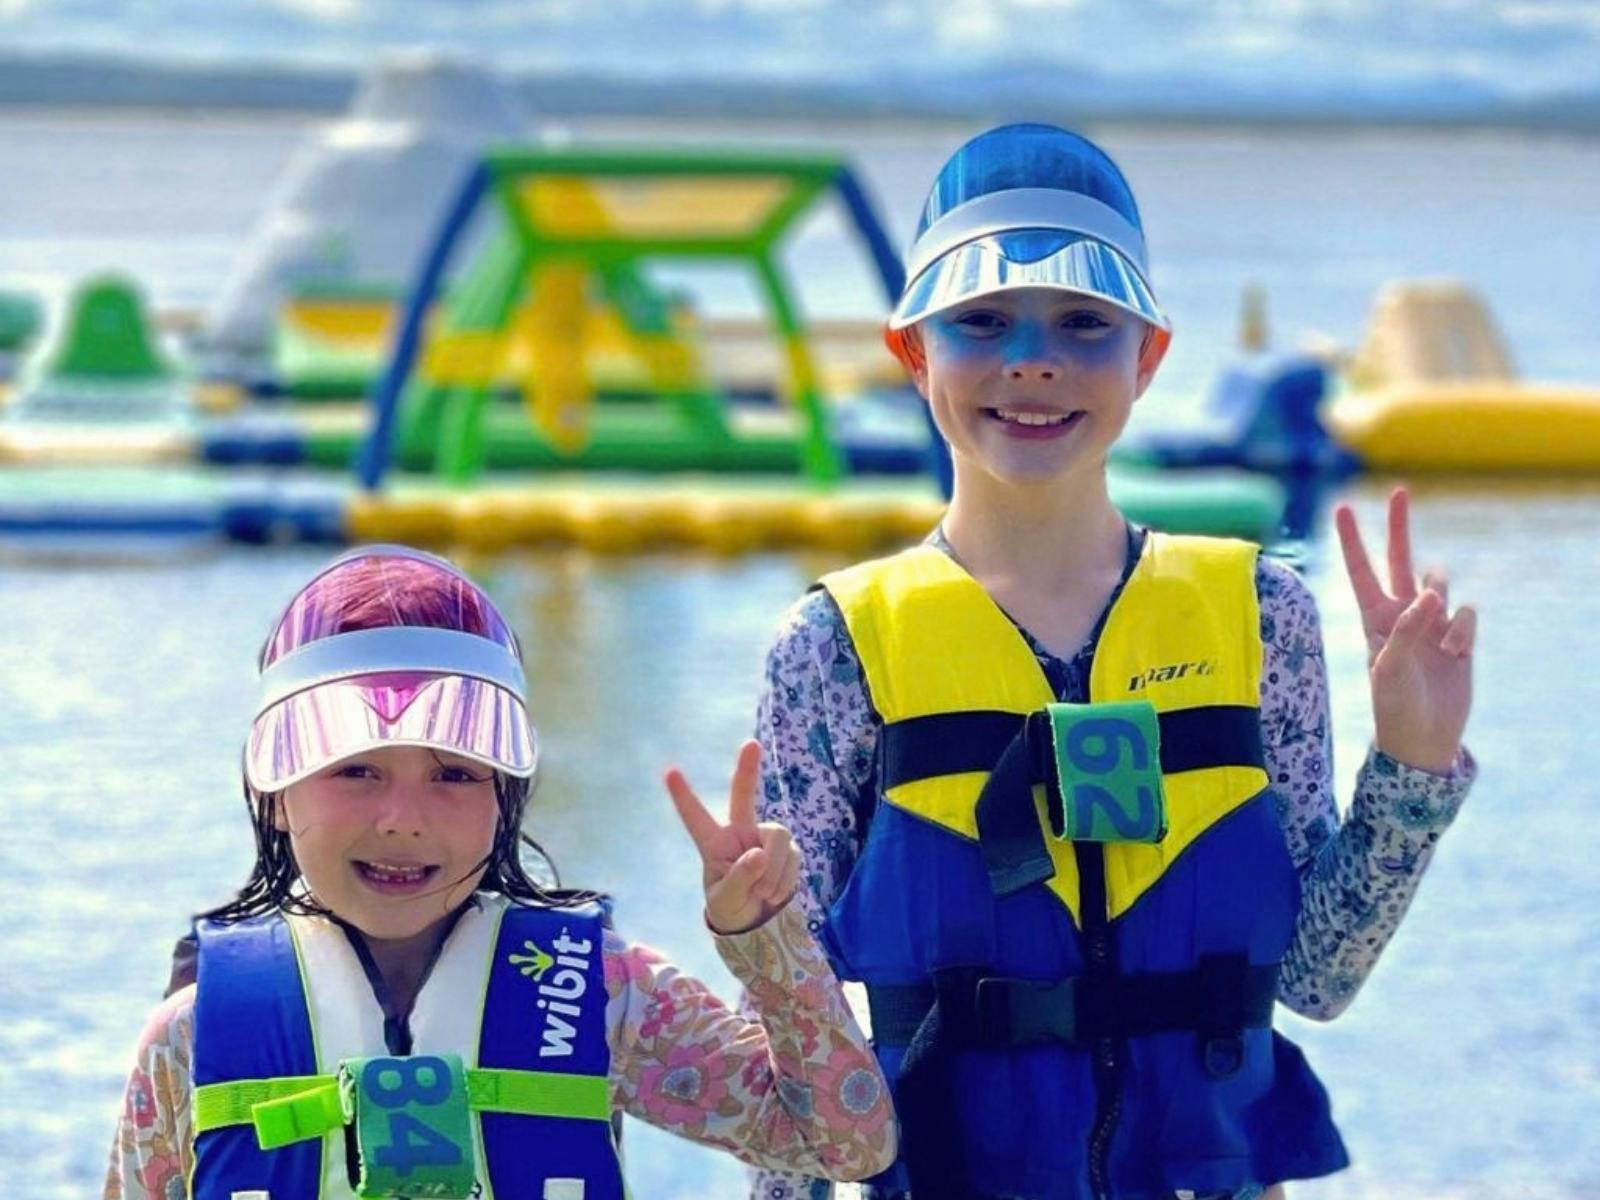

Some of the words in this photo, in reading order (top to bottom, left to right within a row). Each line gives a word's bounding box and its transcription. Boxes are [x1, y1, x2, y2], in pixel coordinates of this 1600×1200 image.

[1066, 717, 1157, 839] 62
[537, 934, 592, 1057] wibit
[363, 1056, 462, 1177] 84
